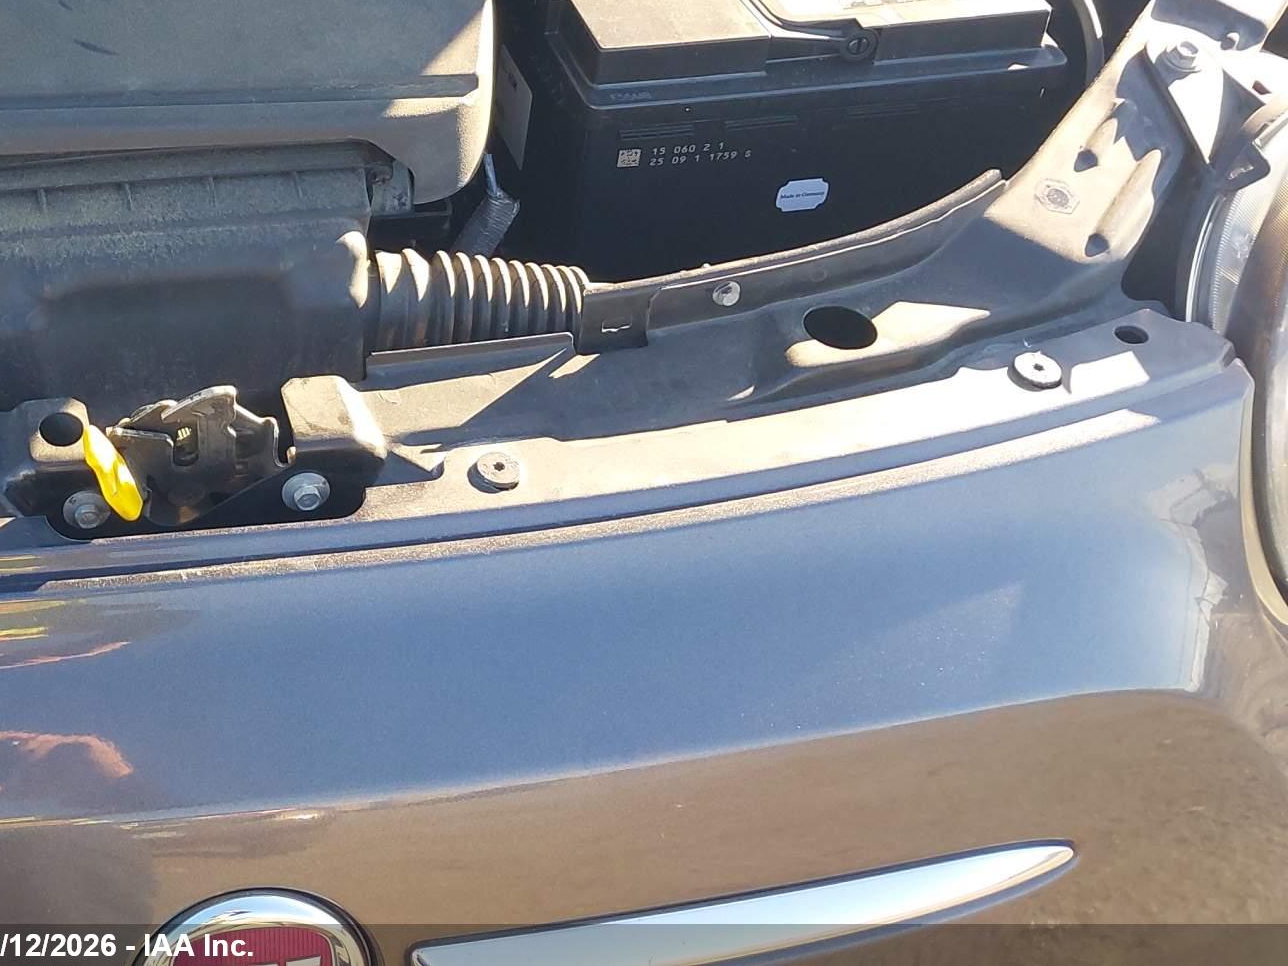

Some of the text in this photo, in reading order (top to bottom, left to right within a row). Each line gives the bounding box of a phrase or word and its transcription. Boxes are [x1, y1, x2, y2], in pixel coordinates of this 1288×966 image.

[653, 142, 724, 155] 15 060 2 1
[649, 157, 665, 166] 25
[672, 156, 687, 164] 09
[709, 151, 737, 161] 1759
